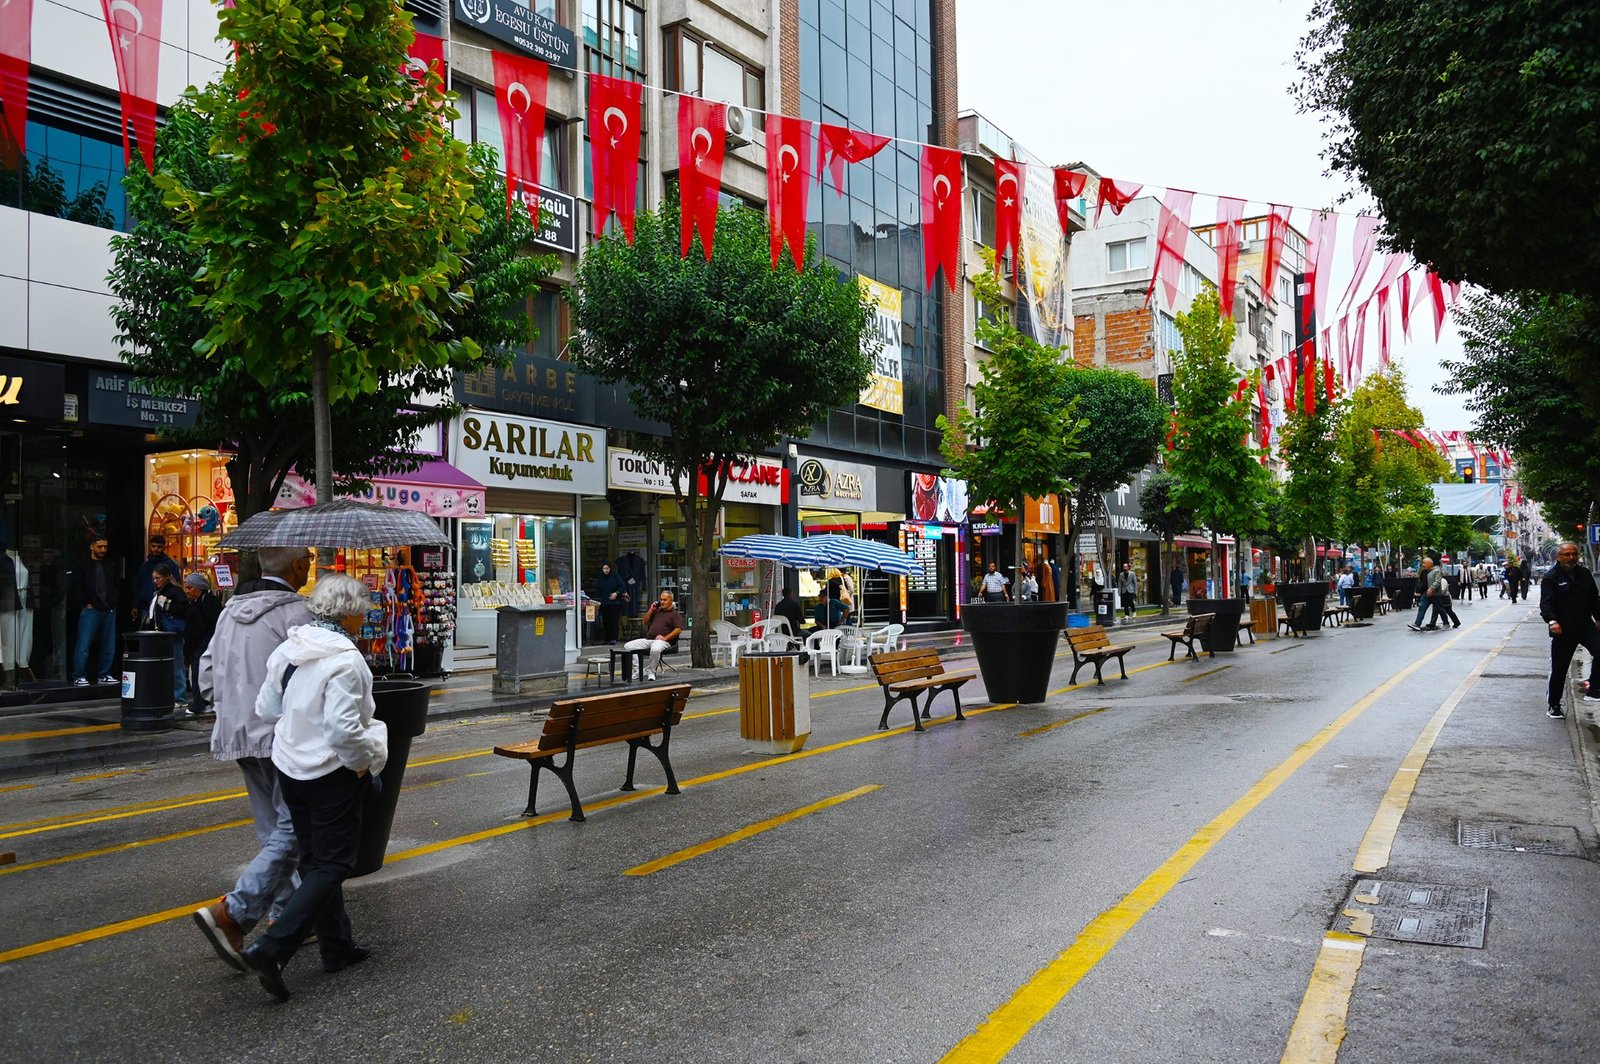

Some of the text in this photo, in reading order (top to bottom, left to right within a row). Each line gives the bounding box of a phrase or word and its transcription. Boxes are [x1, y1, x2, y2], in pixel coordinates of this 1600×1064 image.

[513, 5, 554, 31] AVUKAT
[519, 37, 533, 50] 0532
[533, 26, 569, 55] ÜSTÜN
[544, 229, 557, 242] 88
[95, 375, 126, 393] ARİF
[502, 363, 577, 394] ARBE
[126, 395, 188, 414] İŞ MERKEZİ
[140, 411, 174, 424] No. 11
[463, 417, 595, 463] SARILAR
[489, 456, 573, 482] Kuyumculuk
[618, 457, 661, 475] TORUN
[718, 459, 781, 487] CZANE
[643, 478, 653, 487] No
[658, 479, 665, 487] 13
[835, 472, 863, 491] AZRA
